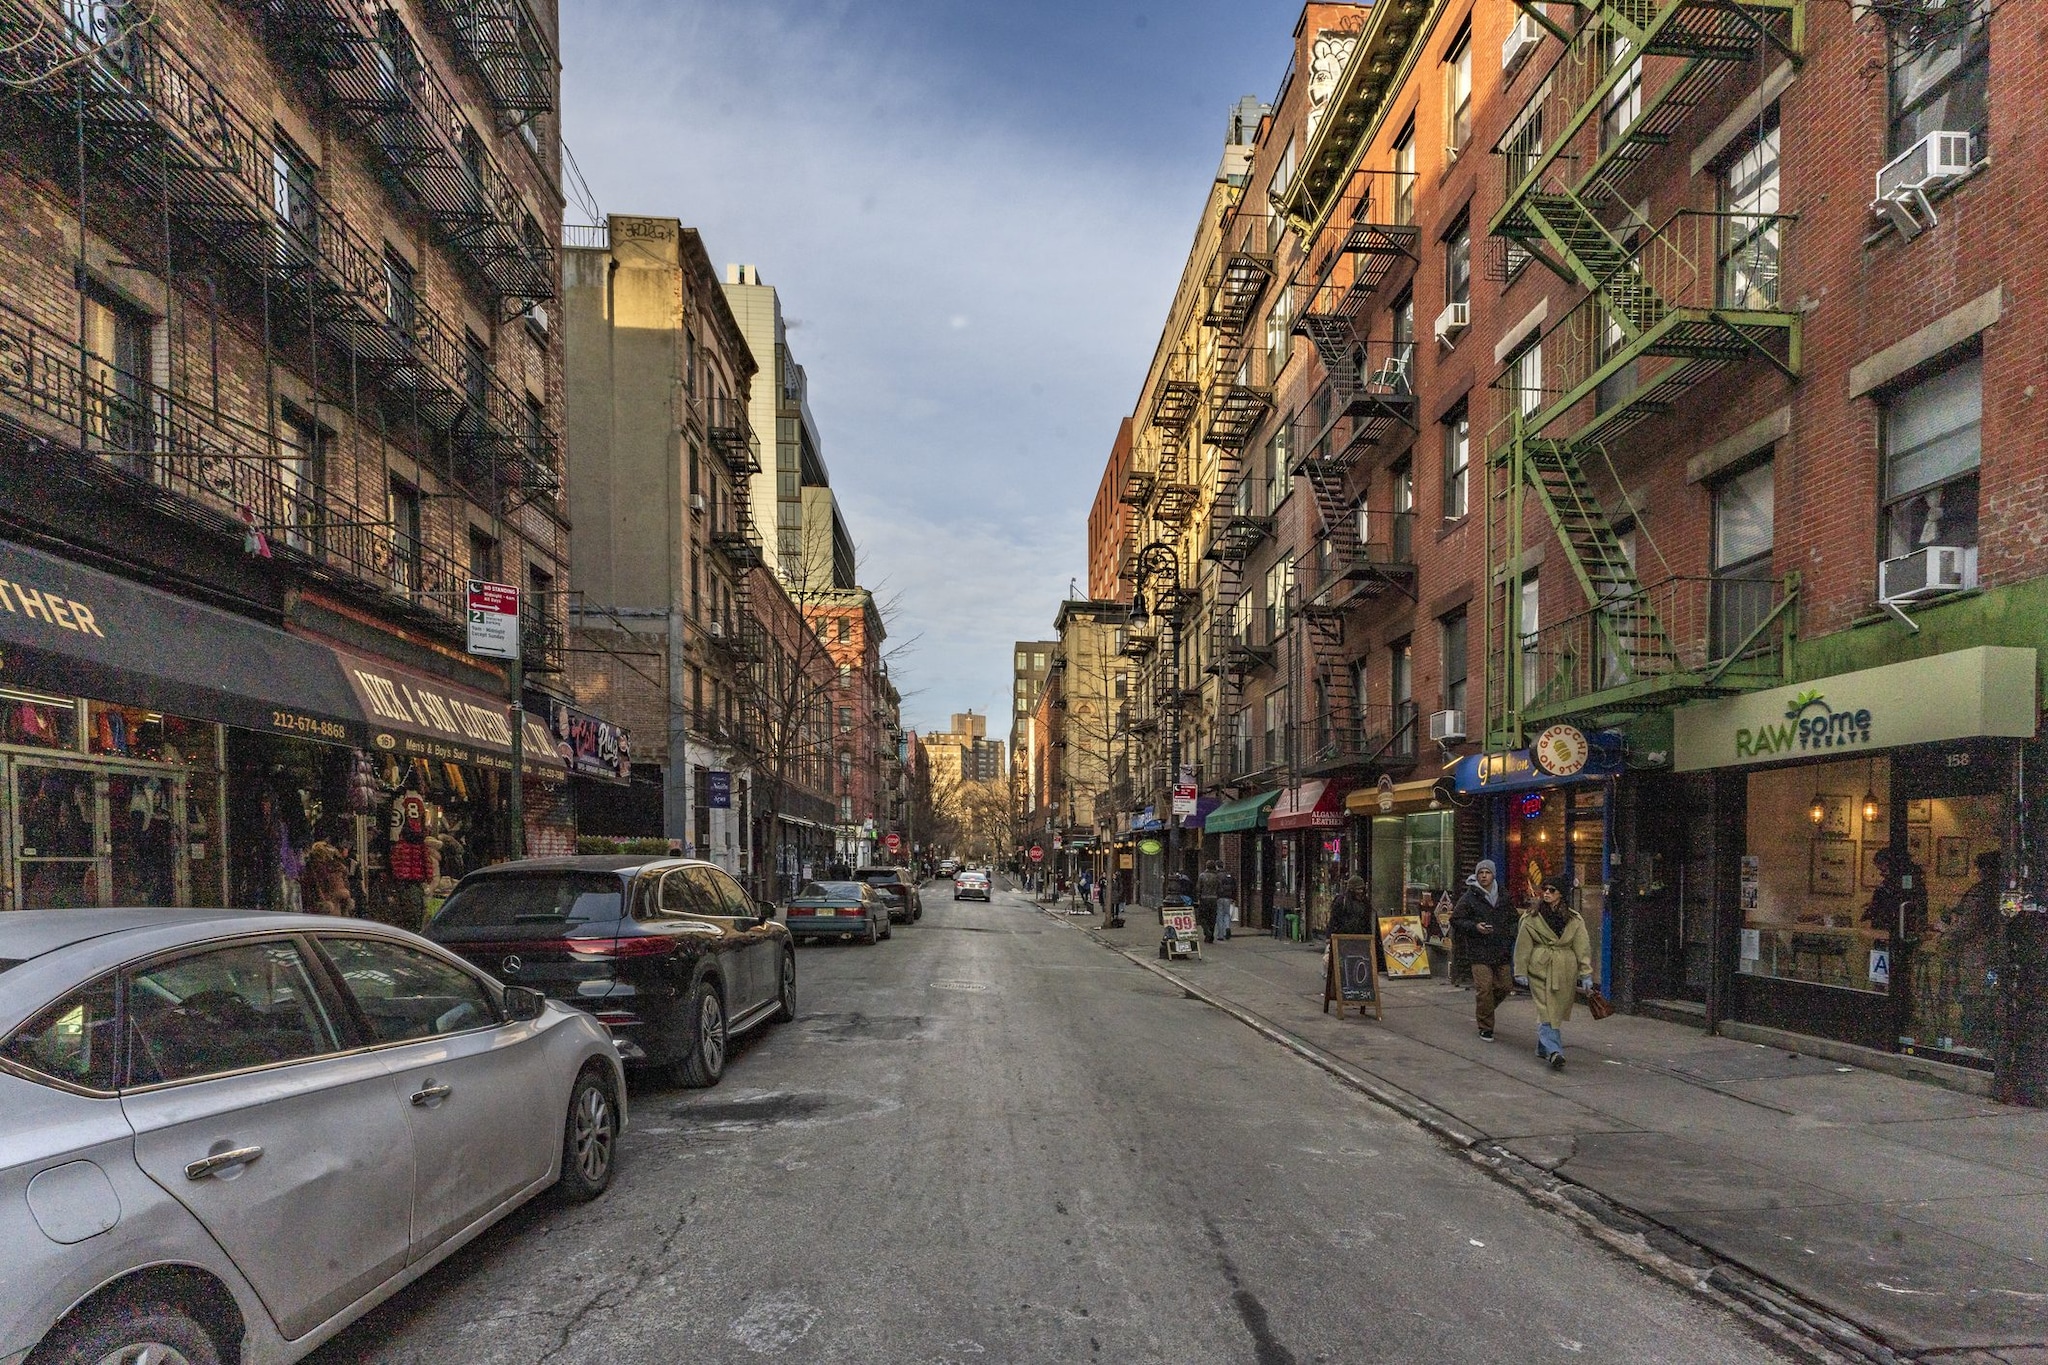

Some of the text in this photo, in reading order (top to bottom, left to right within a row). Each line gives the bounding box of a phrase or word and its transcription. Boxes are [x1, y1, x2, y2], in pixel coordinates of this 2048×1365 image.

[491, 586, 516, 595] STANDING
[0, 579, 105, 638] THER
[473, 610, 481, 622] 2
[354, 669, 413, 723] NICK
[402, 683, 430, 728] &
[417, 689, 461, 735] SON
[272, 711, 346, 739] 212-674-8868
[405, 738, 425, 753] Men's
[426, 743, 433, 755] &
[598, 722, 619, 768] Plug
[1539, 726, 1587, 756] GNOCCHI
[1800, 730, 1871, 751] TREATS
[1540, 754, 1556, 771] ON
[1559, 760, 1582, 775] 9TH
[1946, 753, 1972, 767] 158
[1311, 818, 1344, 826] LEATHER
[886, 836, 899, 845] STOP
[1029, 849, 1043, 857] STOP
[1873, 954, 1889, 975] A
